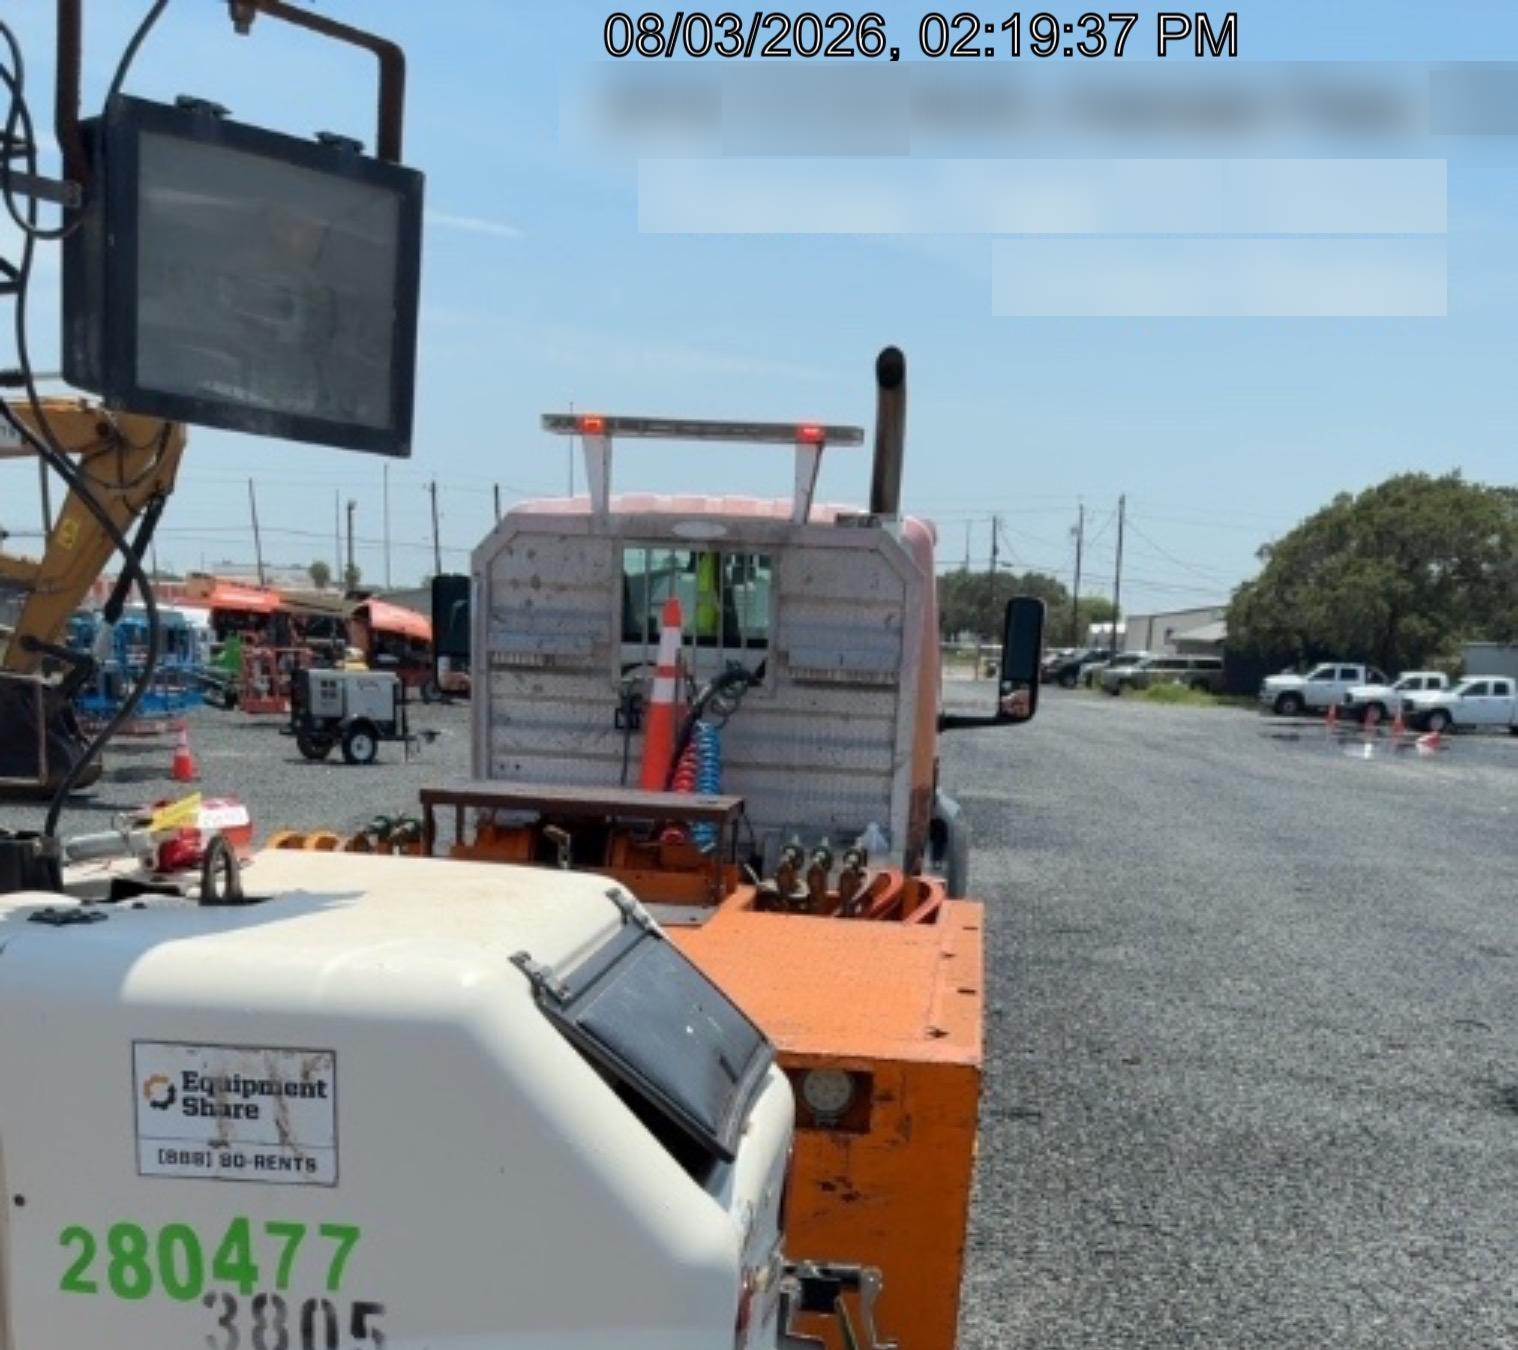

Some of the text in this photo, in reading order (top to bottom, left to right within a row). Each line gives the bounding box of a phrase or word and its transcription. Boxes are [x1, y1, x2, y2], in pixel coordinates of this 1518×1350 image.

[181, 1070, 328, 1099] Equipment
[181, 1096, 259, 1119] Share
[59, 1217, 361, 1301] 280477
